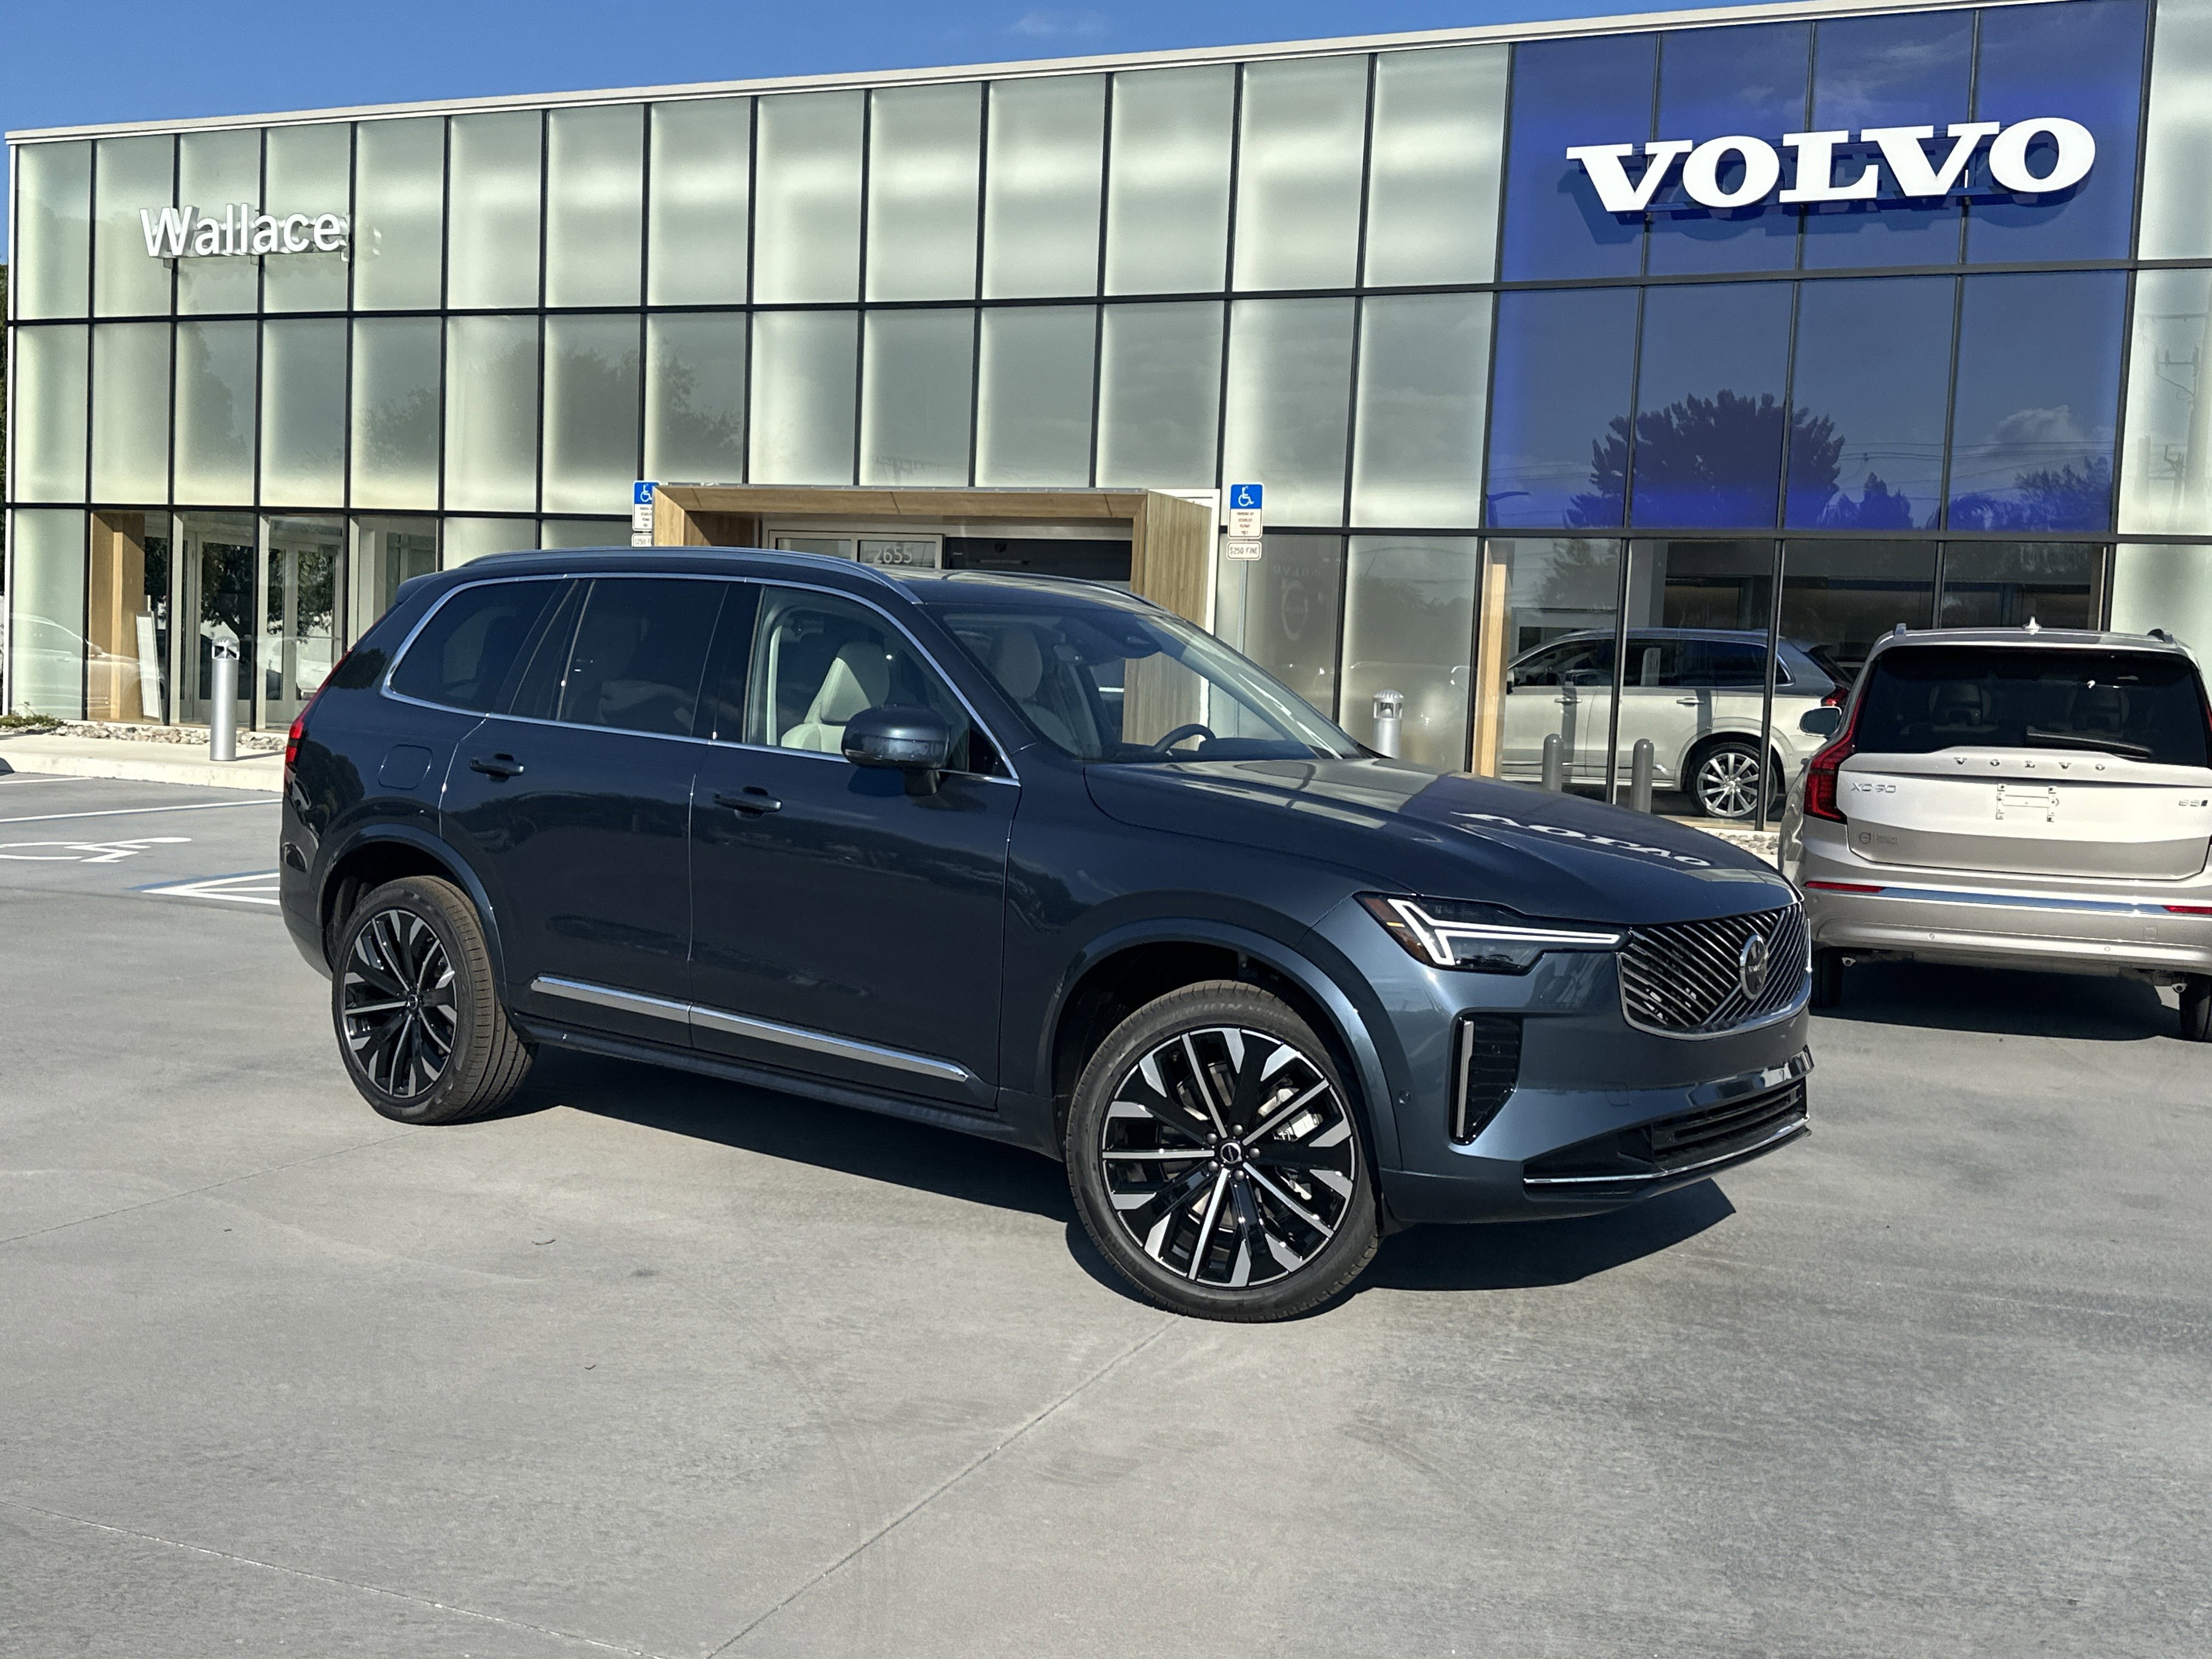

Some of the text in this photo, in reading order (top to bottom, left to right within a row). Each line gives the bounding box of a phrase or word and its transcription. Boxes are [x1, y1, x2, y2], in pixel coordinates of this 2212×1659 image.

[1566, 117, 2096, 212] VOLVO
[139, 202, 347, 257] Wallace
[874, 546, 912, 563] 2655
[1229, 546, 1244, 555] $250
[1954, 757, 2106, 771] VOLVO
